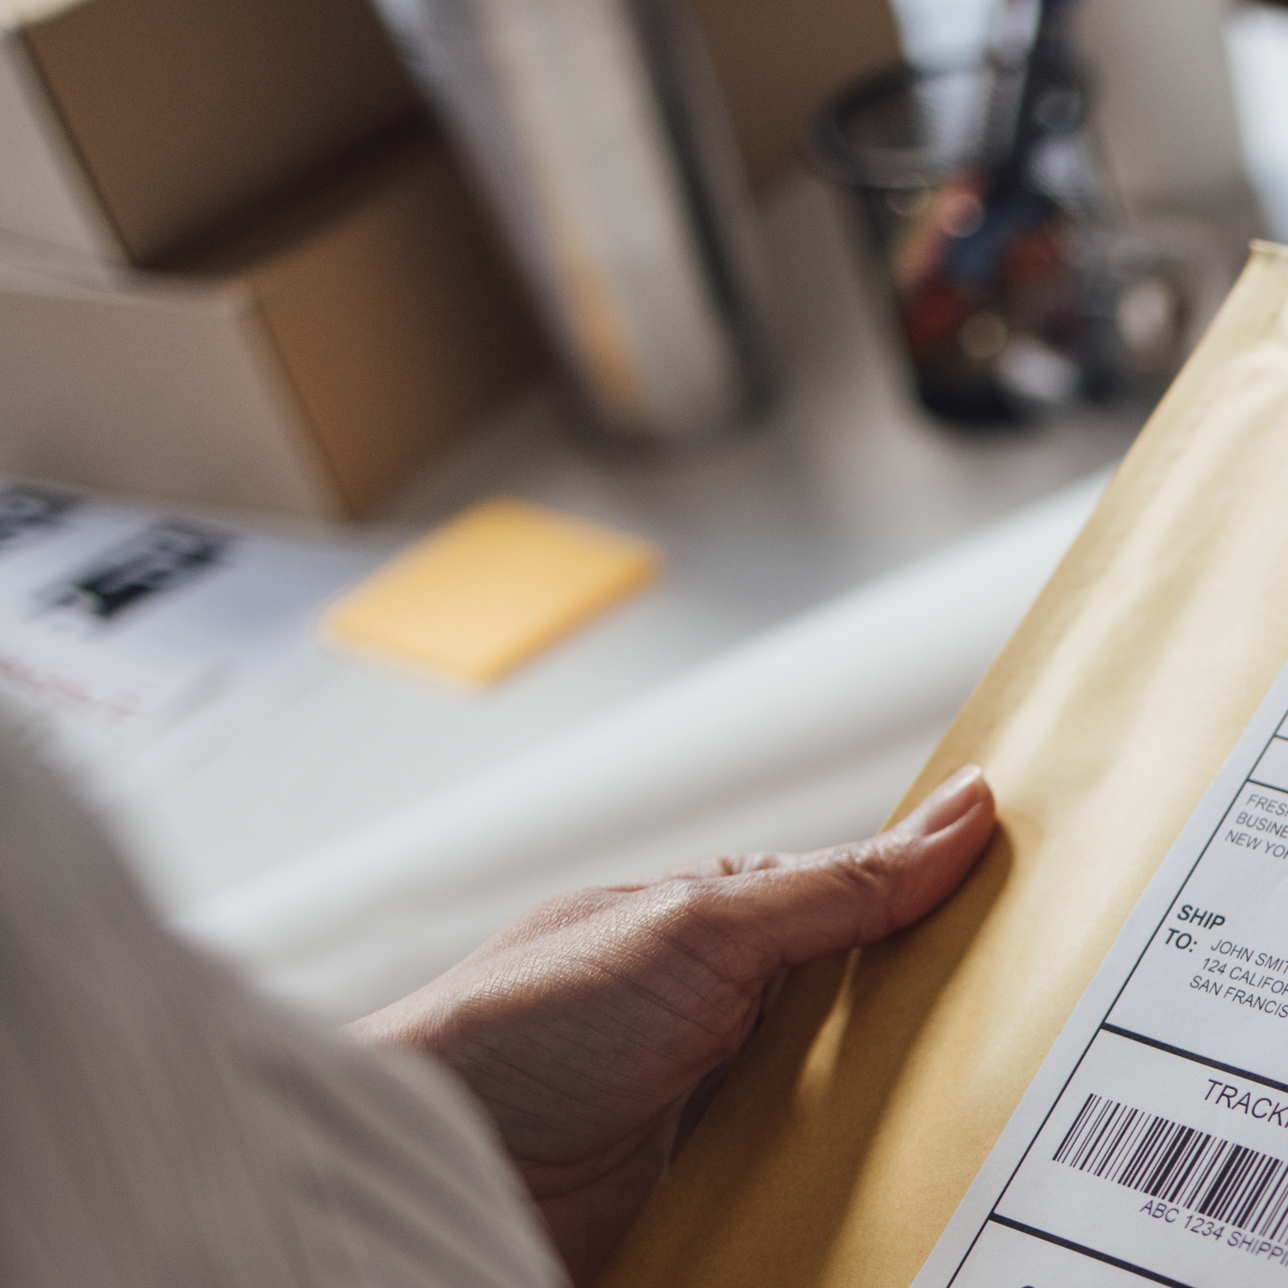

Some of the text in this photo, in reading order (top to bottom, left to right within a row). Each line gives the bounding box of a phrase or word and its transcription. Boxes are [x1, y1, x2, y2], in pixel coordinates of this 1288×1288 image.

[1225, 830, 1262, 850] NEW
[1177, 904, 1225, 930] SHIP
[1165, 928, 1197, 952] TO:
[1210, 939, 1254, 962] JOHN
[1202, 957, 1226, 975] 124
[1190, 975, 1223, 996] SAN
[1139, 1199, 1180, 1224] ABC
[1183, 1214, 1225, 1244] 1234
